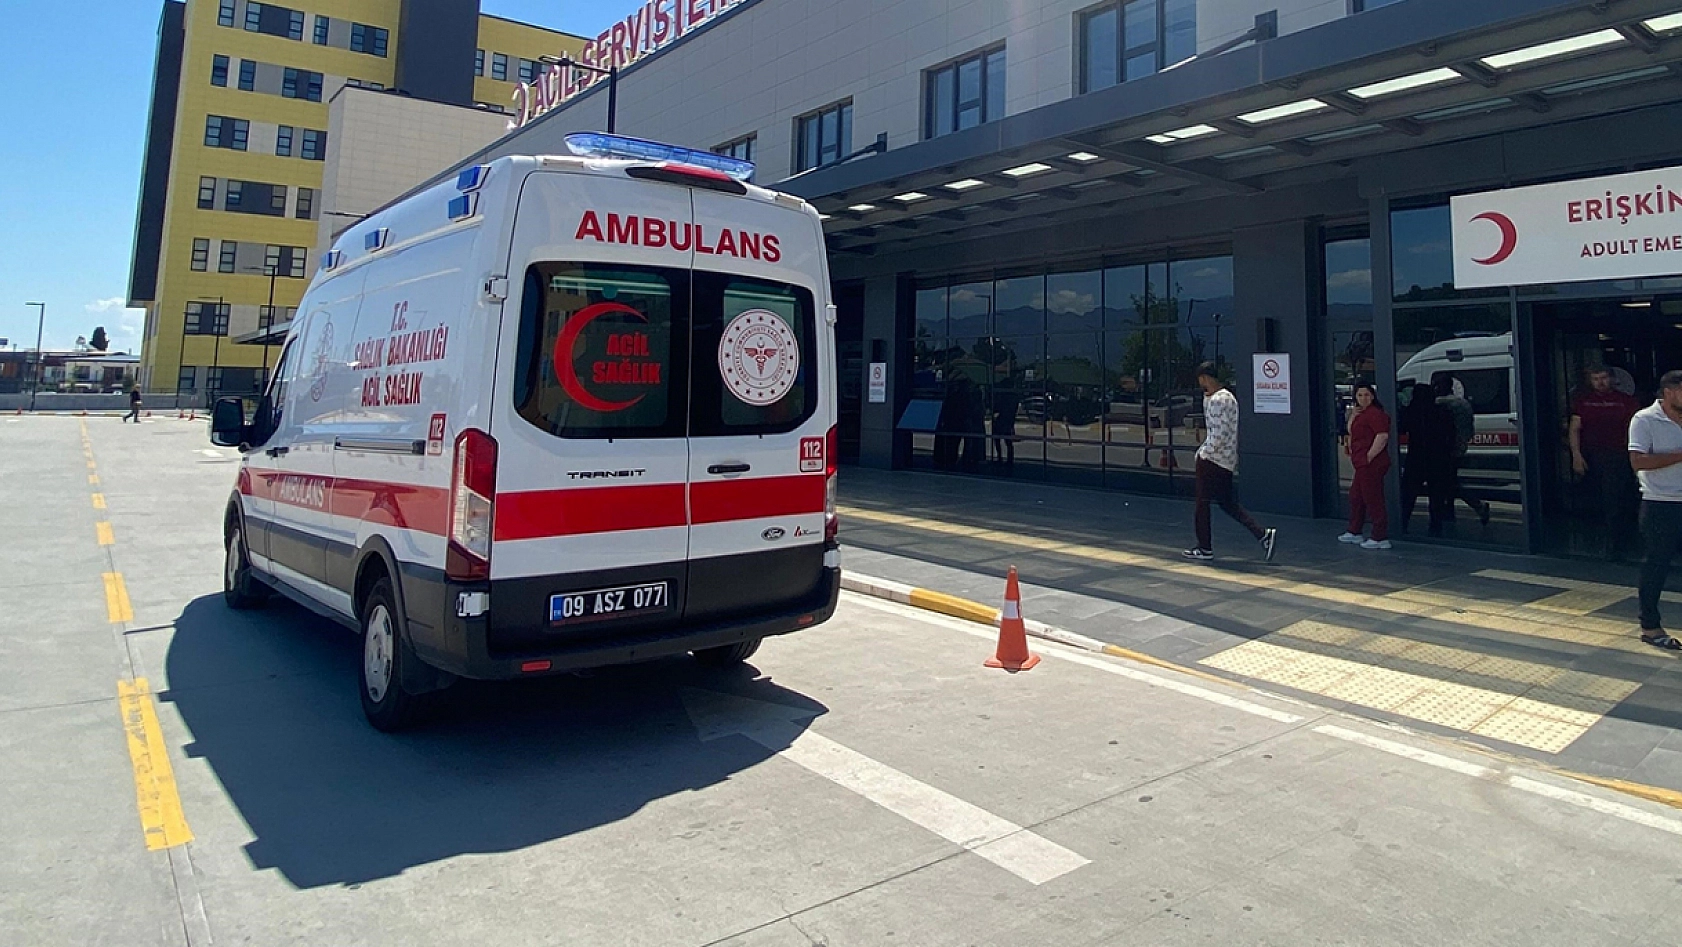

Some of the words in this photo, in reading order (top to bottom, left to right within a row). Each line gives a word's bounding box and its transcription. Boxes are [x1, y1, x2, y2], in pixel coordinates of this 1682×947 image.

[1568, 184, 1682, 224] ERİŞKİN
[575, 210, 781, 262] AMBULANS
[1580, 239, 1638, 258] ADULT
[387, 321, 449, 366] BAKANLIĞI
[607, 331, 649, 356] ACİL
[593, 358, 661, 384] SAĞLIK
[361, 370, 381, 407] ACİL
[384, 368, 423, 406] SAĞLIK
[803, 441, 821, 458] 112
[567, 468, 646, 479] TRANSIT
[563, 595, 584, 618] 09
[593, 590, 626, 614] ASZ
[633, 586, 663, 608] 077
